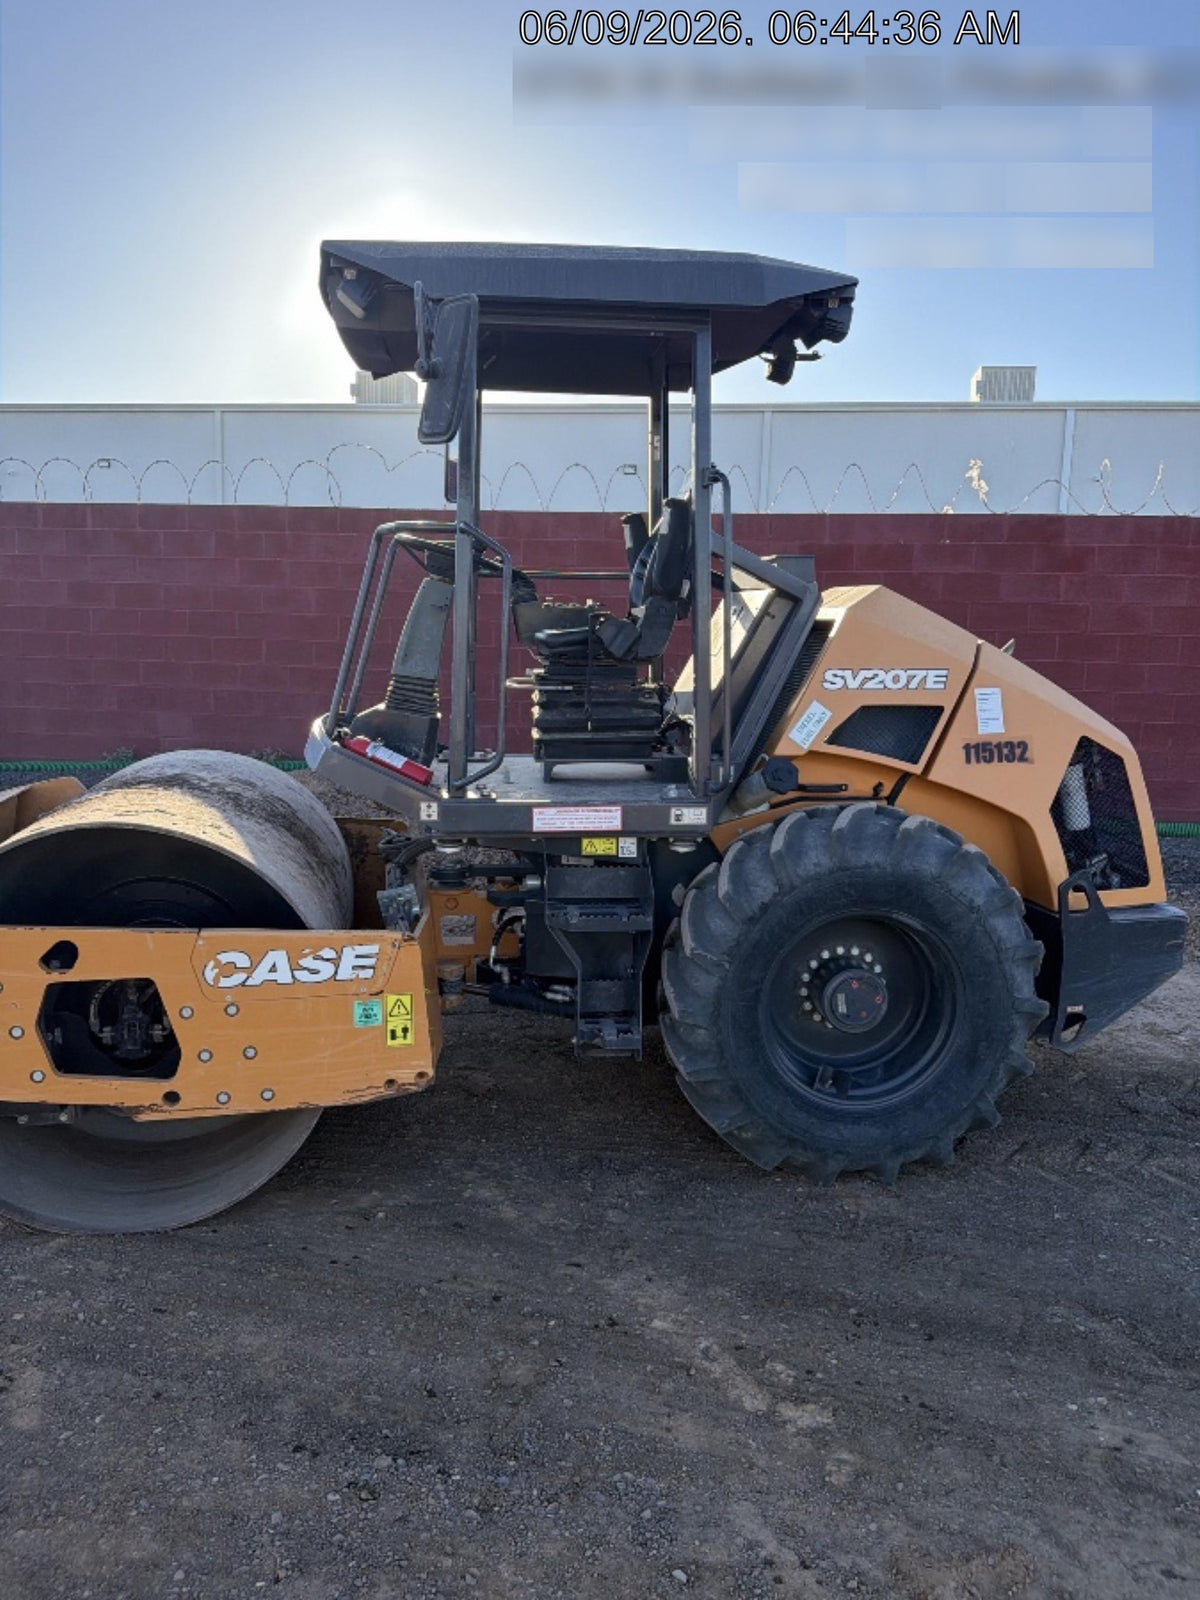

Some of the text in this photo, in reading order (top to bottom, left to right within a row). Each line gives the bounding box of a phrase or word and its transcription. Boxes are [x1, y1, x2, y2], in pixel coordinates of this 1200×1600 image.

[822, 668, 949, 690] SV207E
[962, 740, 1028, 764] 115132
[203, 944, 380, 988] CASE
